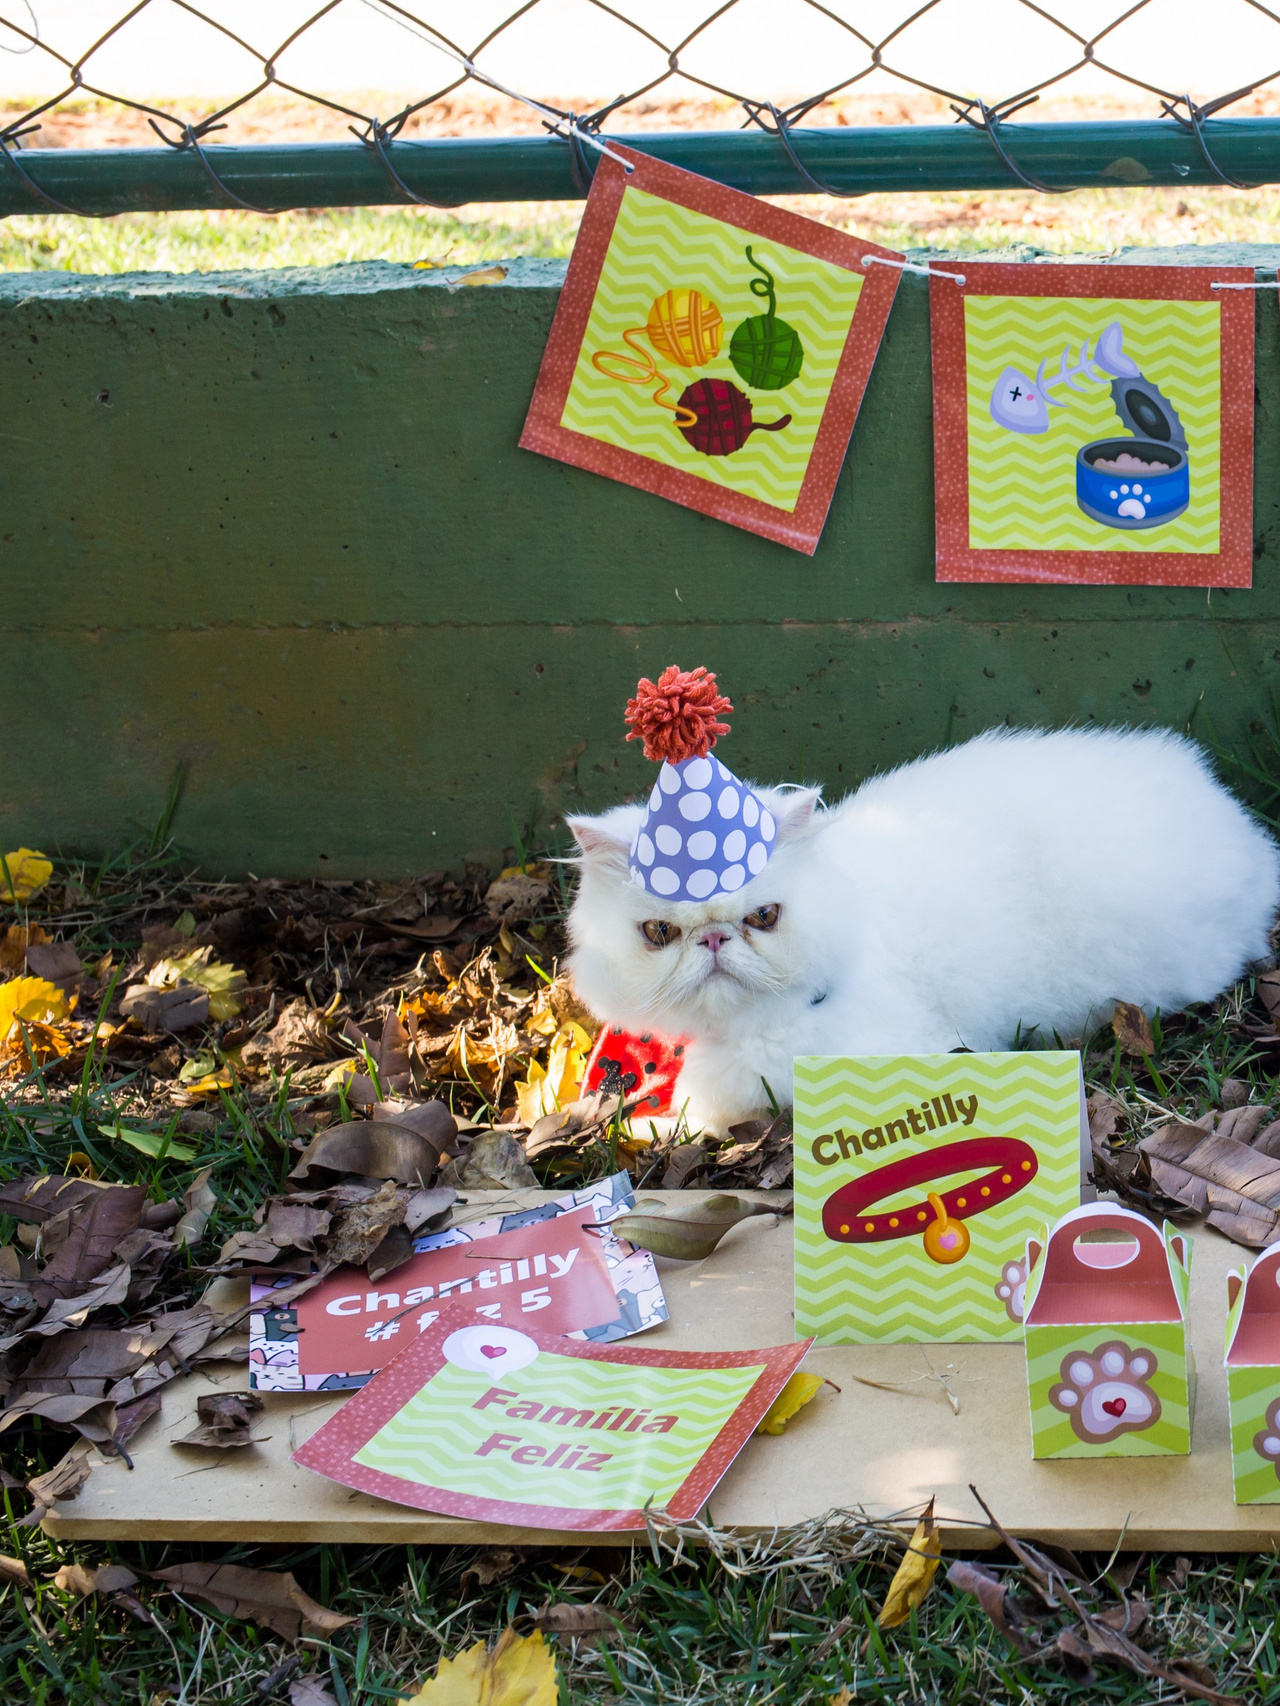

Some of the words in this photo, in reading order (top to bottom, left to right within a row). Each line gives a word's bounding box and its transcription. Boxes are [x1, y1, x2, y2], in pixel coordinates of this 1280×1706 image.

[811, 1093, 979, 1166] Chantilly
[325, 1247, 580, 1317] Chantilly
[364, 1320, 401, 1342] #
[417, 1302, 502, 1333] fz
[521, 1286, 552, 1313] 5
[471, 1386, 679, 1434] Família
[473, 1432, 614, 1472] Feliz
